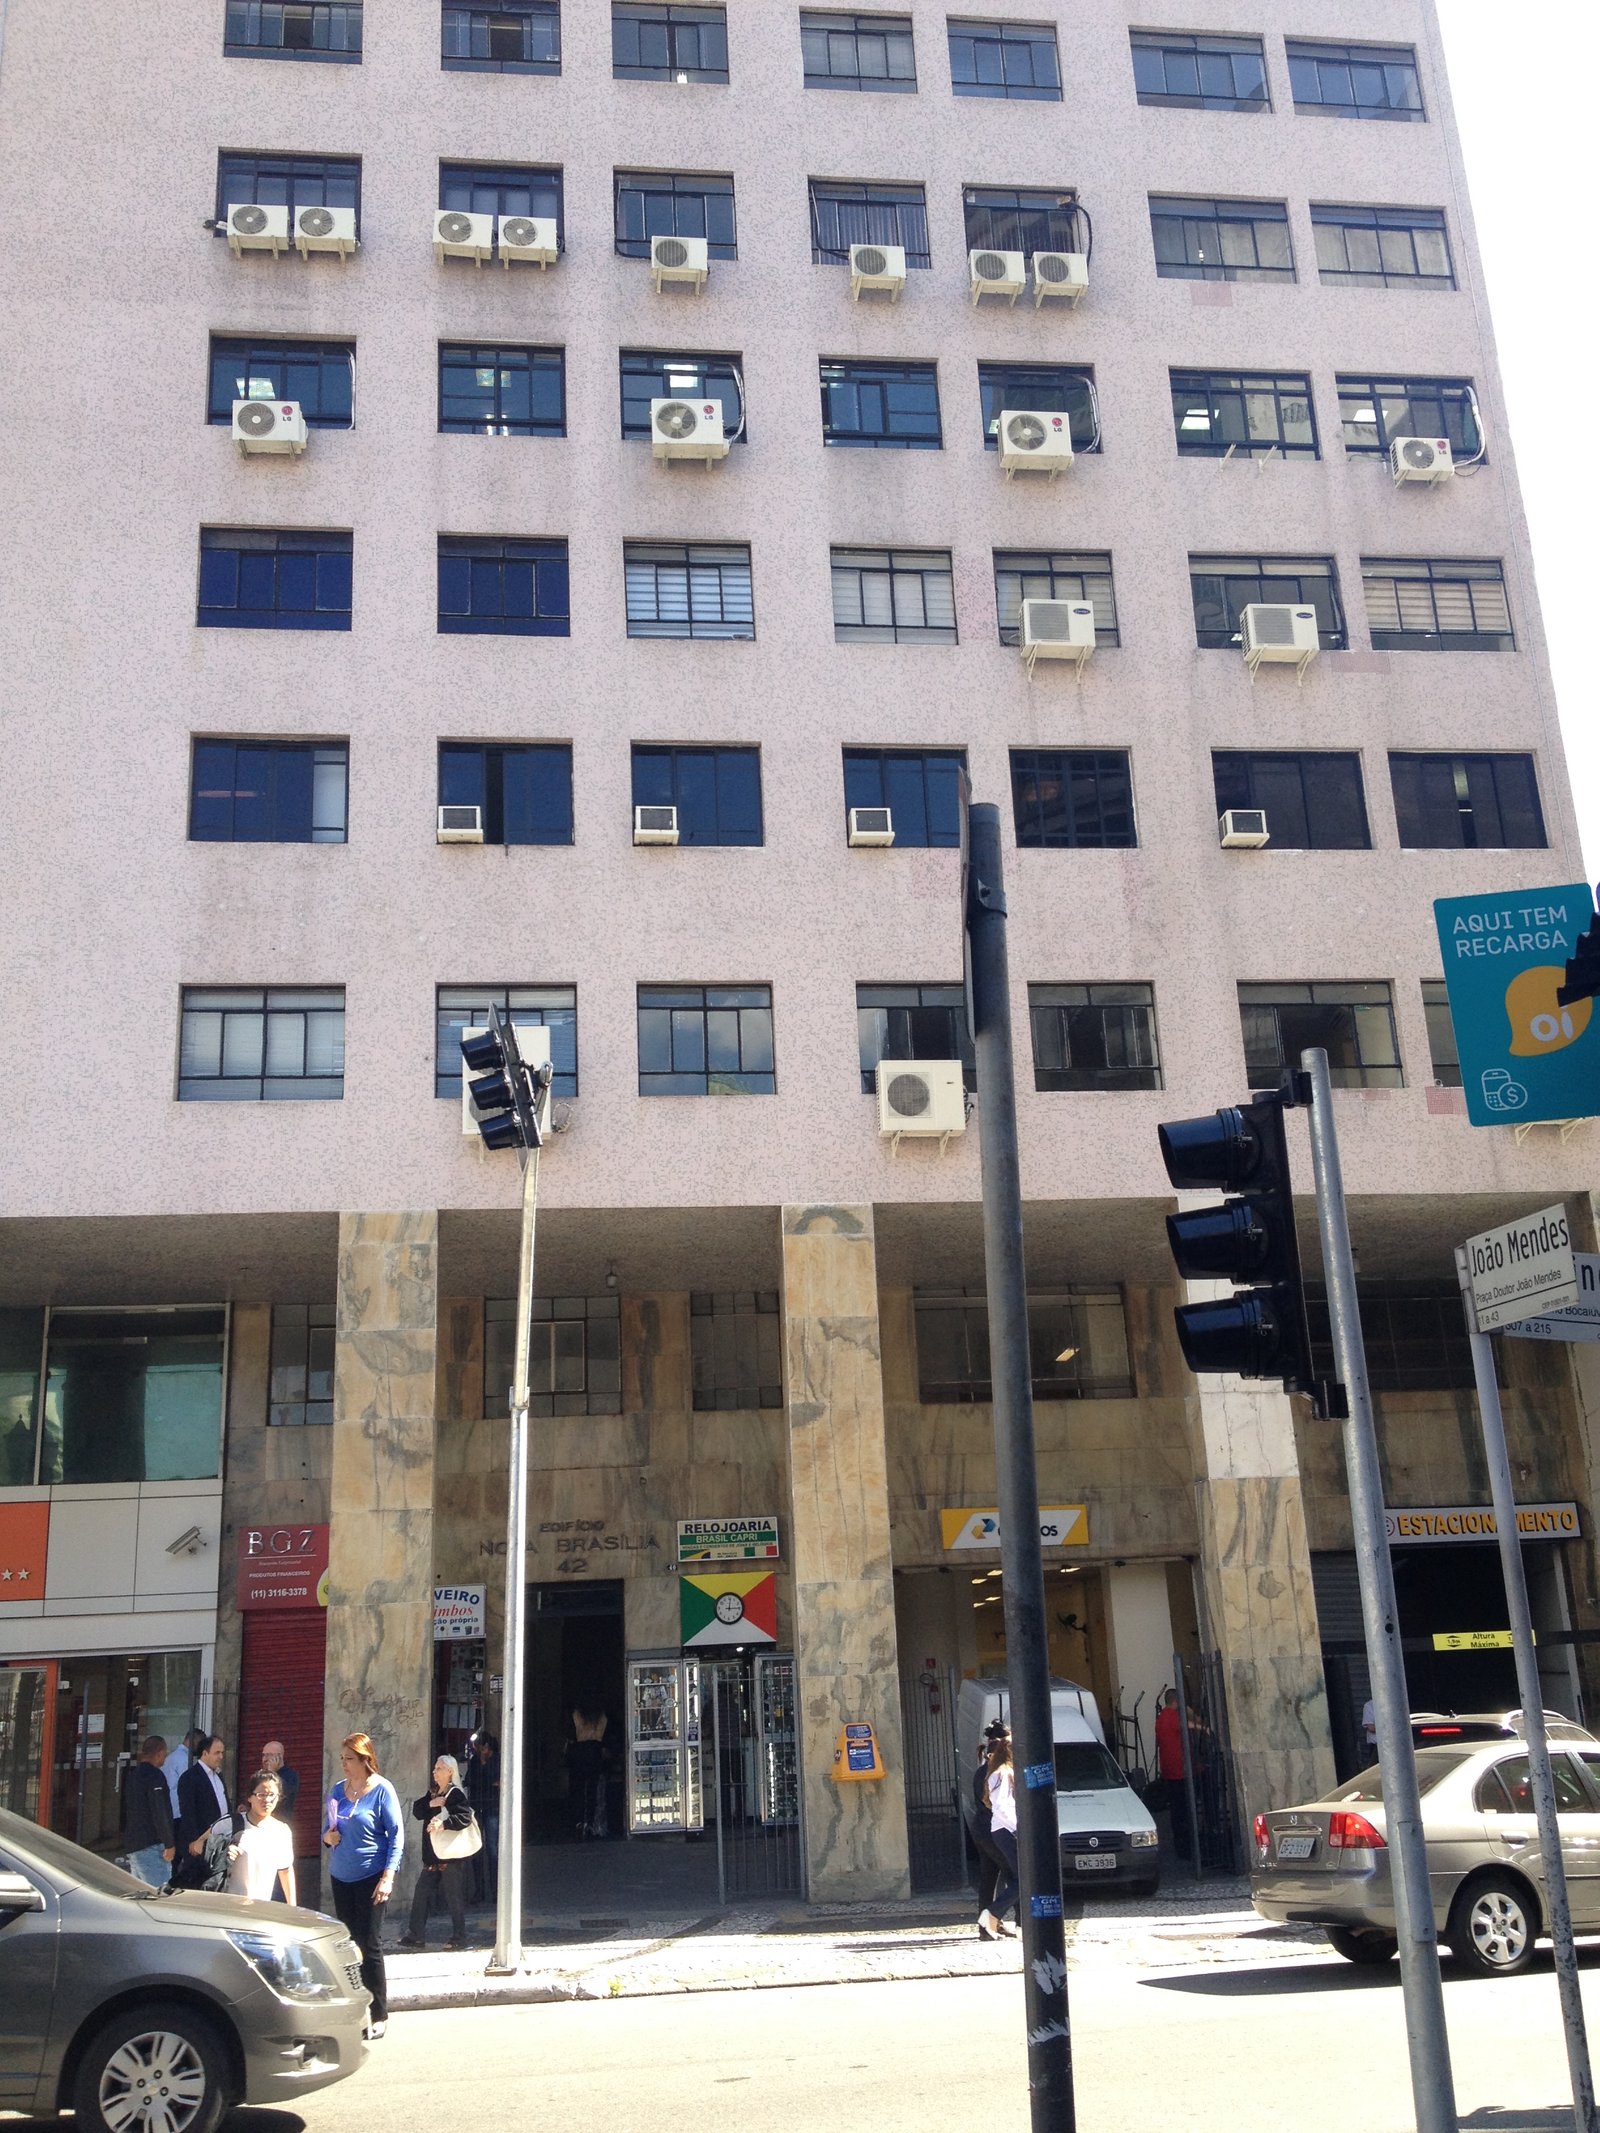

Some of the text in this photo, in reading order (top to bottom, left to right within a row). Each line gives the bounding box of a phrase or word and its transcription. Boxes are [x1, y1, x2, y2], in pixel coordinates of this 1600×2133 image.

[1453, 905, 1568, 935] AQUI TEM
[1456, 930, 1568, 958] RECARGA
[1471, 1217, 1569, 1277] João Mendes
[1476, 1269, 1561, 1304] Praça Doutor João Mendes
[1491, 1310, 1500, 1321] 43
[1535, 1323, 1552, 1334] 215
[539, 1519, 605, 1533] EDIFÍCIO
[684, 1520, 771, 1534] RELOJOARIA
[1397, 1508, 1575, 1537] ESTACIONENTO
[247, 1530, 315, 1555] BGZ
[479, 1533, 660, 1556] NOA BRASÍLIA
[696, 1533, 758, 1543] BRASIL CAPRI
[556, 1558, 588, 1573] 42
[251, 1587, 307, 1599] (11) 3116-3378
[449, 1616, 479, 1626] própria
[1472, 1632, 1496, 1640] Altura
